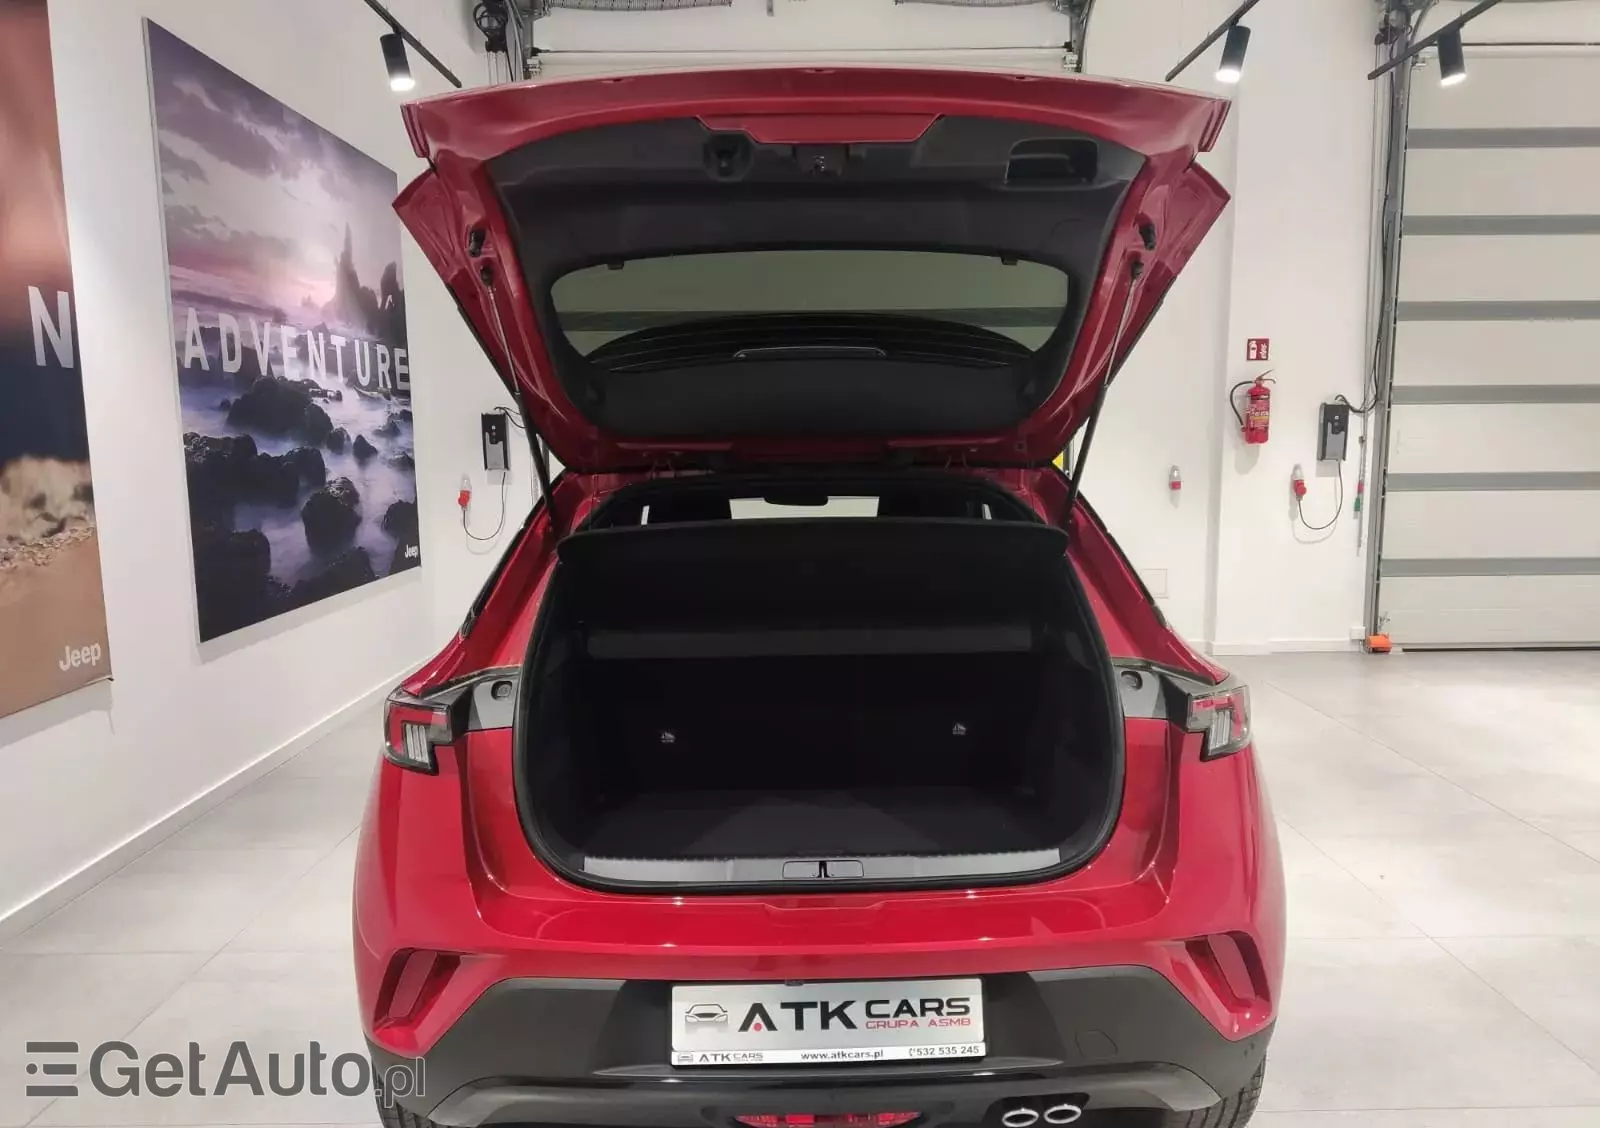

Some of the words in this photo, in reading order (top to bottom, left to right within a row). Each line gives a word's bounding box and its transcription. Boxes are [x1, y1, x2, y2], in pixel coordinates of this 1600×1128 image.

[184, 306, 410, 390] ADVENTURE
[404, 544, 419, 558] Jeep
[59, 642, 101, 671] Jeep
[738, 1000, 858, 1033] ATK
[865, 997, 970, 1019] CARS
[865, 1019, 919, 1030] GRUPA
[927, 1017, 971, 1028] ASMB
[699, 1053, 731, 1062] ATK
[733, 1052, 764, 1060] CARS
[801, 1049, 884, 1061] www.atkcars.pl
[916, 1047, 936, 1056] 532
[938, 1046, 958, 1055] 535
[960, 1045, 980, 1055] 245
